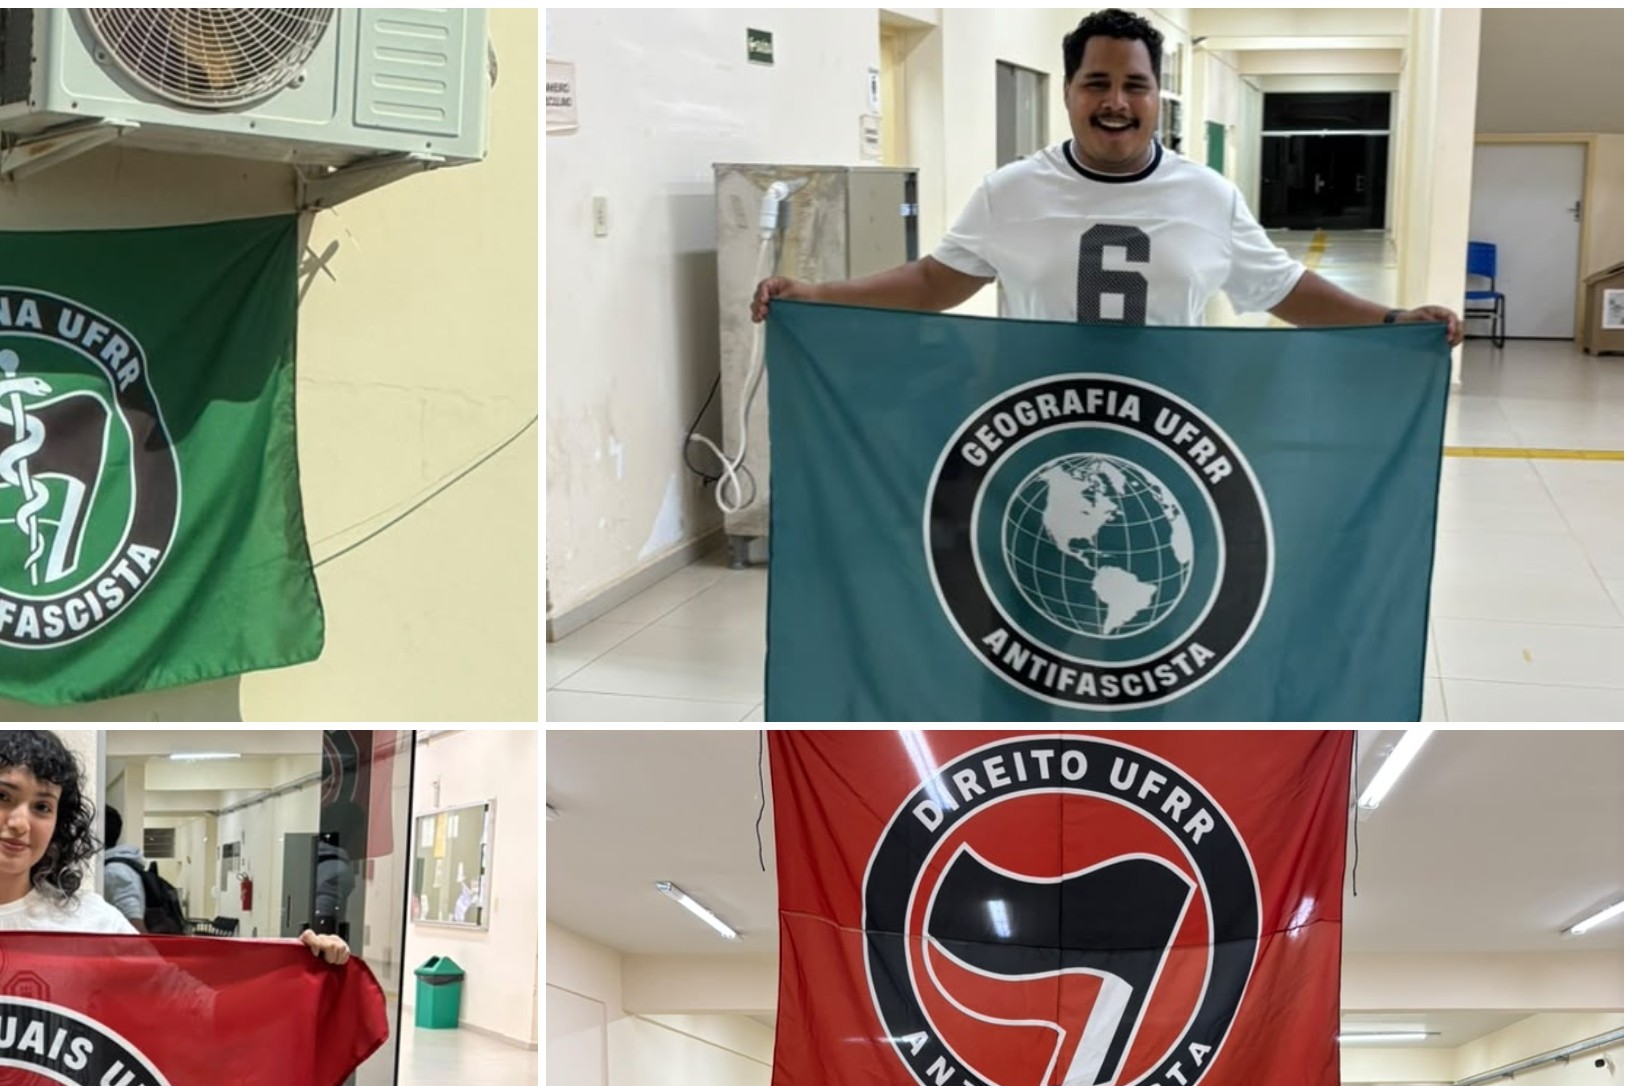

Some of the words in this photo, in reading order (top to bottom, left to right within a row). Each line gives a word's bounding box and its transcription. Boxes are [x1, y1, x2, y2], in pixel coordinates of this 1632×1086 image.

[1077, 222, 1151, 326] 6
[57, 307, 140, 393] UFRR
[961, 388, 1142, 468] GEOGRAFIA
[1153, 407, 1234, 486] UFRR
[982, 627, 1217, 698] ANTIFASCISTA
[911, 749, 1088, 833] DIREITO
[1109, 757, 1216, 845] UFRR
